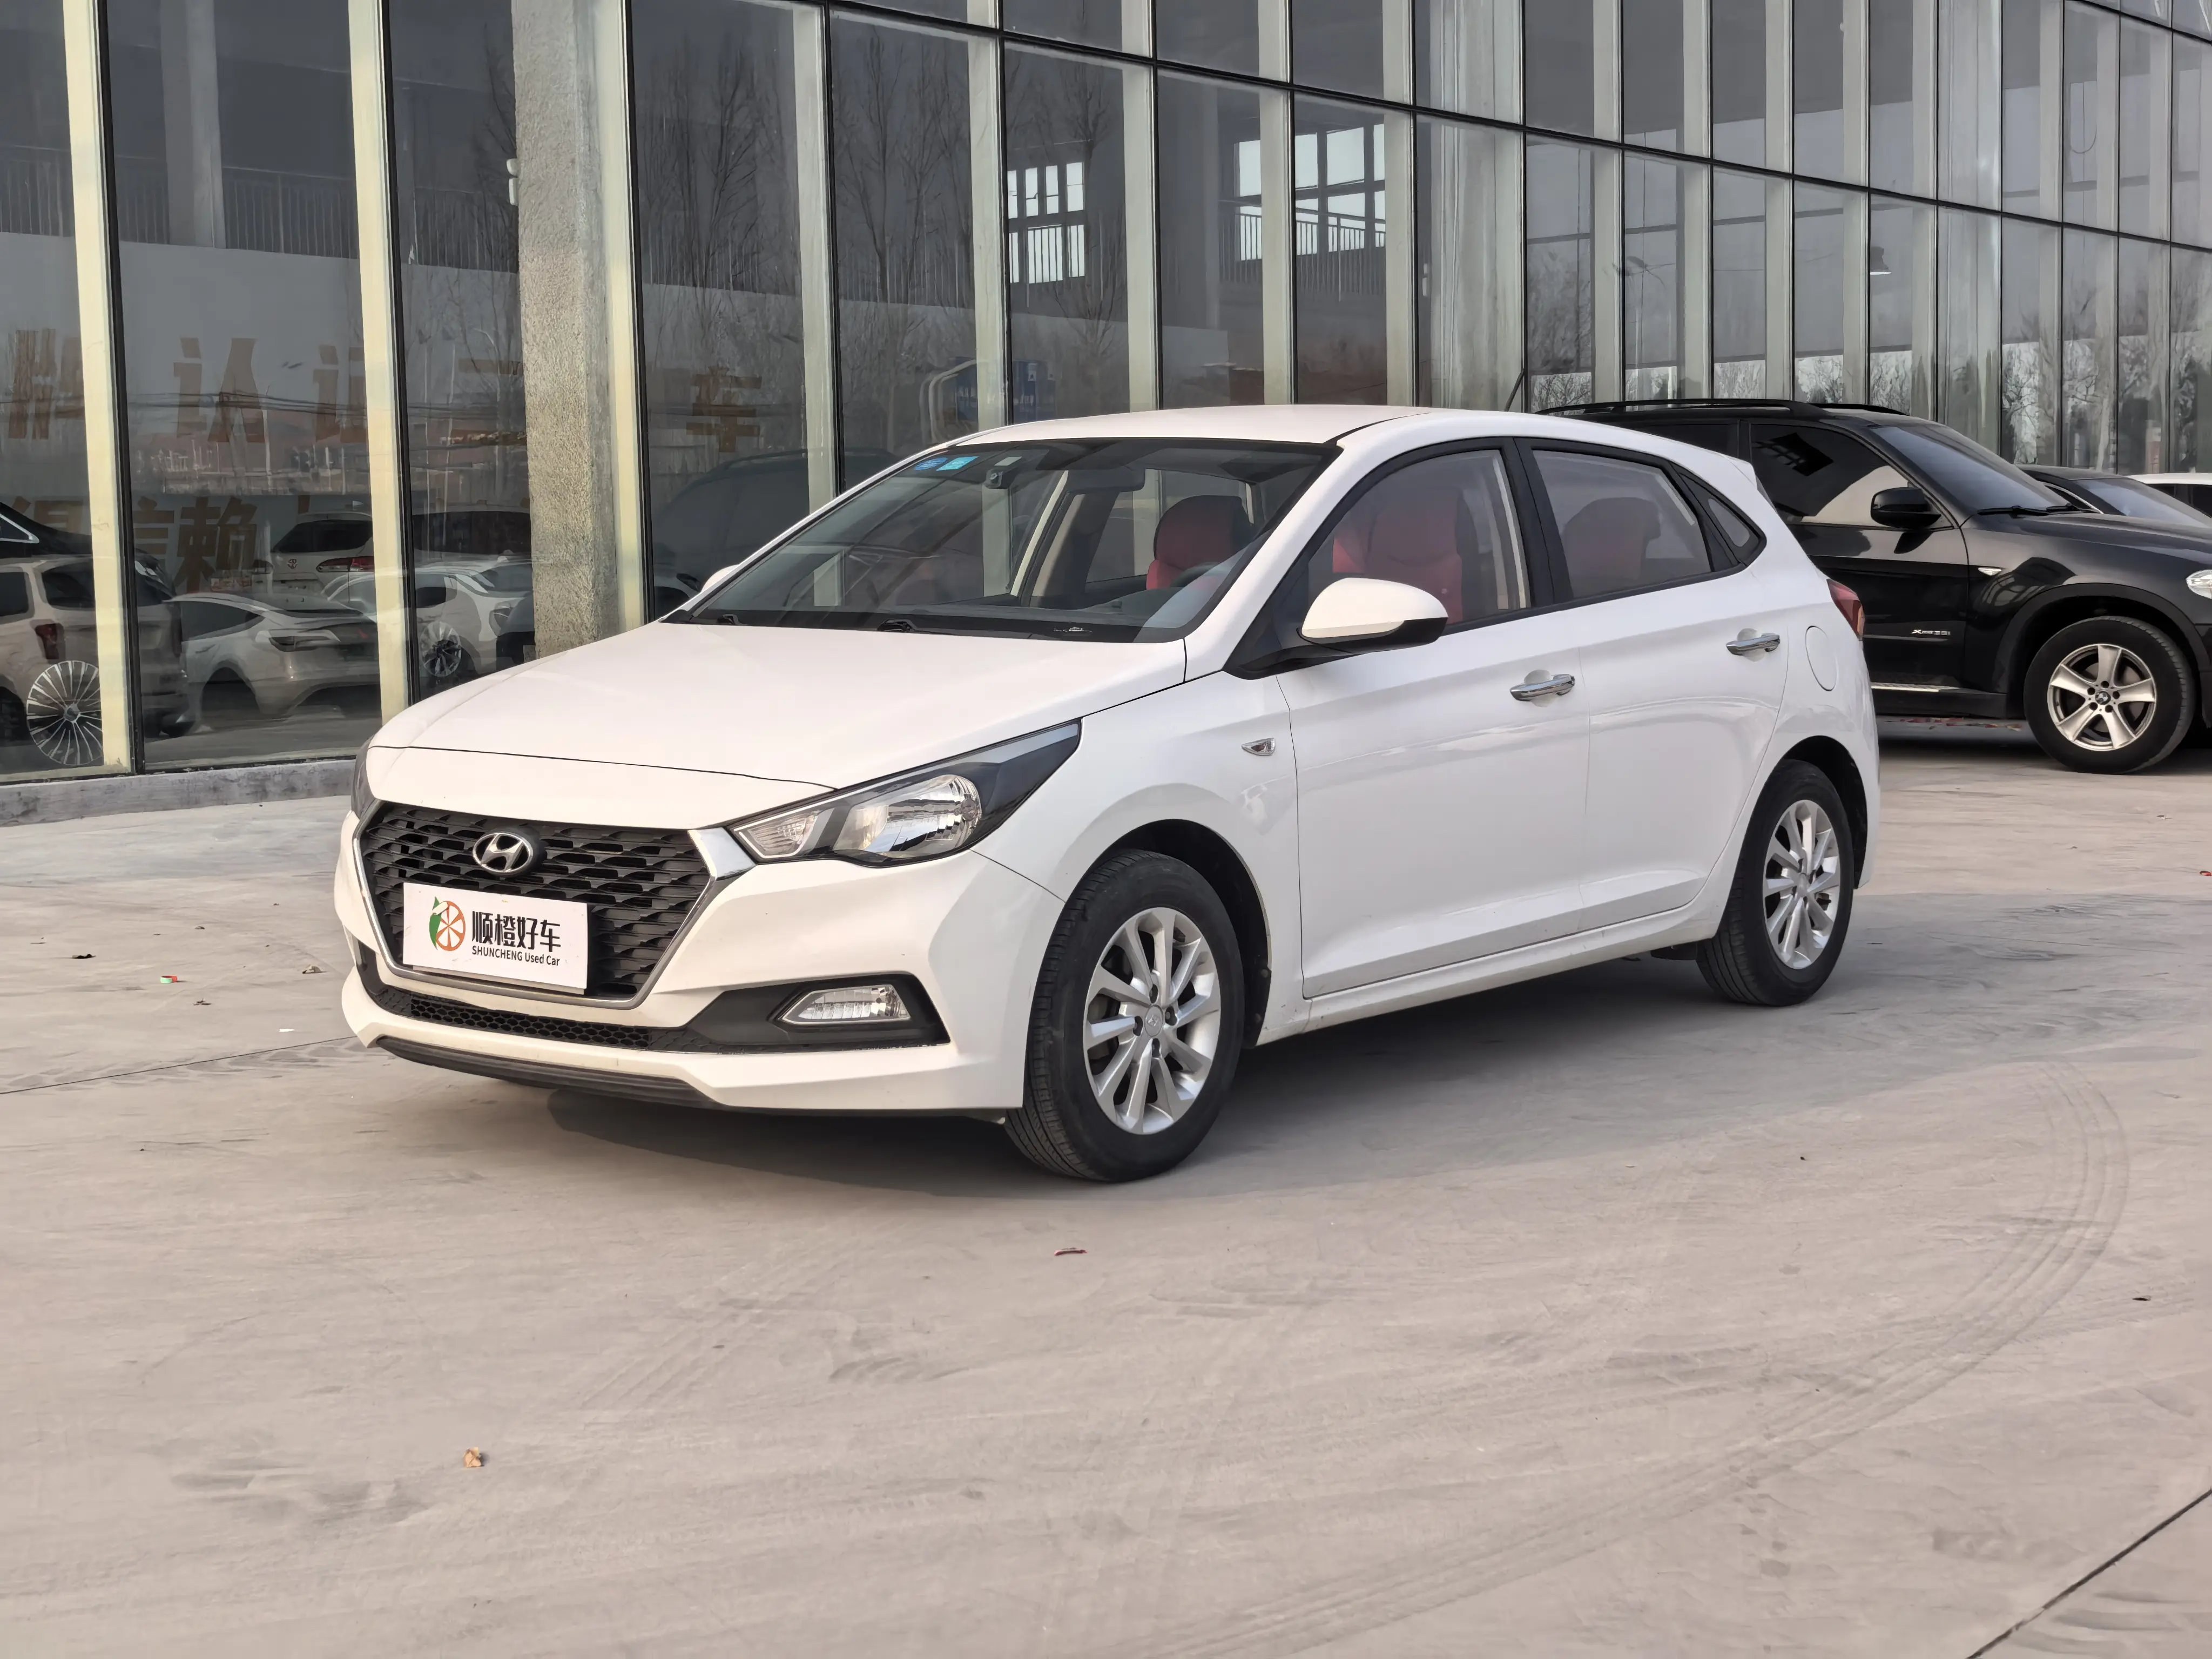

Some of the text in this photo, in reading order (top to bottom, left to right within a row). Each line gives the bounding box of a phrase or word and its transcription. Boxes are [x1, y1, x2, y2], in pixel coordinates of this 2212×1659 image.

[471, 911, 561, 953] 顺橙好车
[471, 945, 561, 966] SHUNCHENG Used Car
